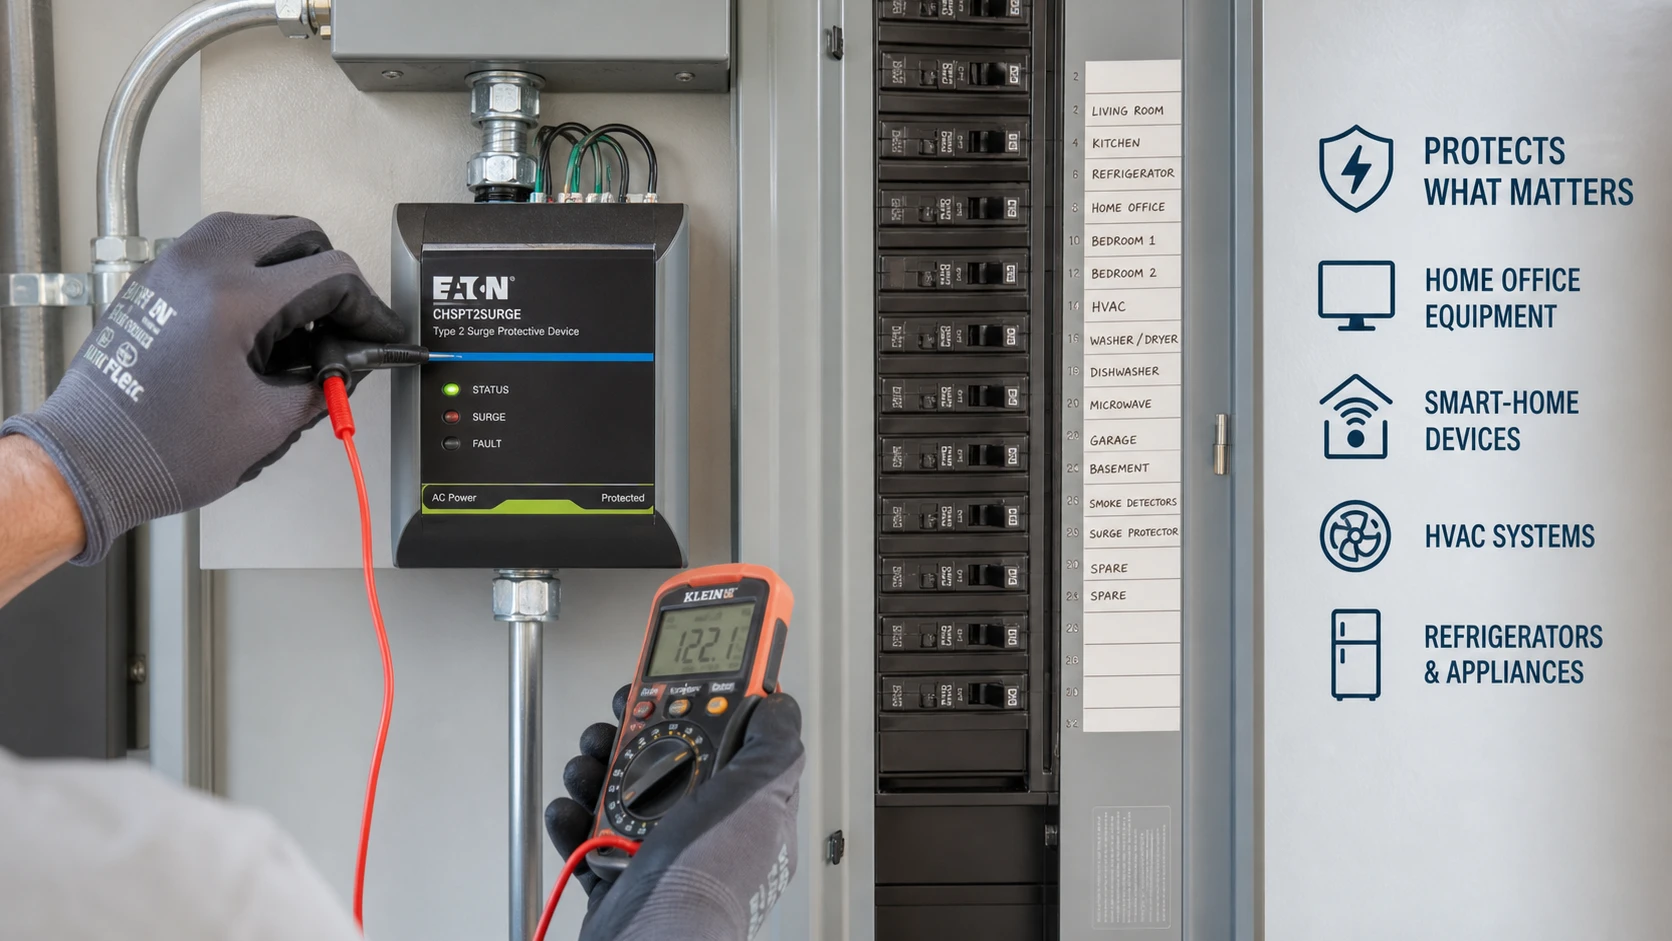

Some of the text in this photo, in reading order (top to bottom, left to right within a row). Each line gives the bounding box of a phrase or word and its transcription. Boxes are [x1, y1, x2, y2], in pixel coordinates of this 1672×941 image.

[1092, 106, 1163, 116] LIVING ROOM
[1093, 138, 1140, 148] KITCHEN
[1093, 168, 1175, 179] REFRIGERATOR
[1092, 202, 1165, 213] HOME OFFICE
[1092, 236, 1156, 246] BEDROOM 1
[1092, 268, 1157, 279] BEDROOM 2
[1093, 301, 1126, 312] HVAC
[433, 308, 522, 320] CHSPT2SURGE
[432, 325, 580, 338] Type 2 Surge Protective Device
[1091, 366, 1159, 377] DISHWASHER
[472, 384, 510, 395] STATUS
[1090, 399, 1151, 410] MICROWAVE
[472, 412, 506, 422] SURGE
[472, 438, 502, 449] FAULT
[1090, 435, 1136, 446] GARAGE
[1090, 463, 1149, 474] BASEMENT
[431, 492, 478, 503] AC Power
[601, 493, 645, 503] Protected
[1090, 498, 1177, 508] SMOKE DETECTORS
[1090, 528, 1178, 538] SURGE PROTECTOR
[1091, 564, 1128, 574] SPARE
[683, 588, 724, 603] KLEIN
[1091, 591, 1126, 601] SPARE
[674, 626, 739, 664] 122.1
